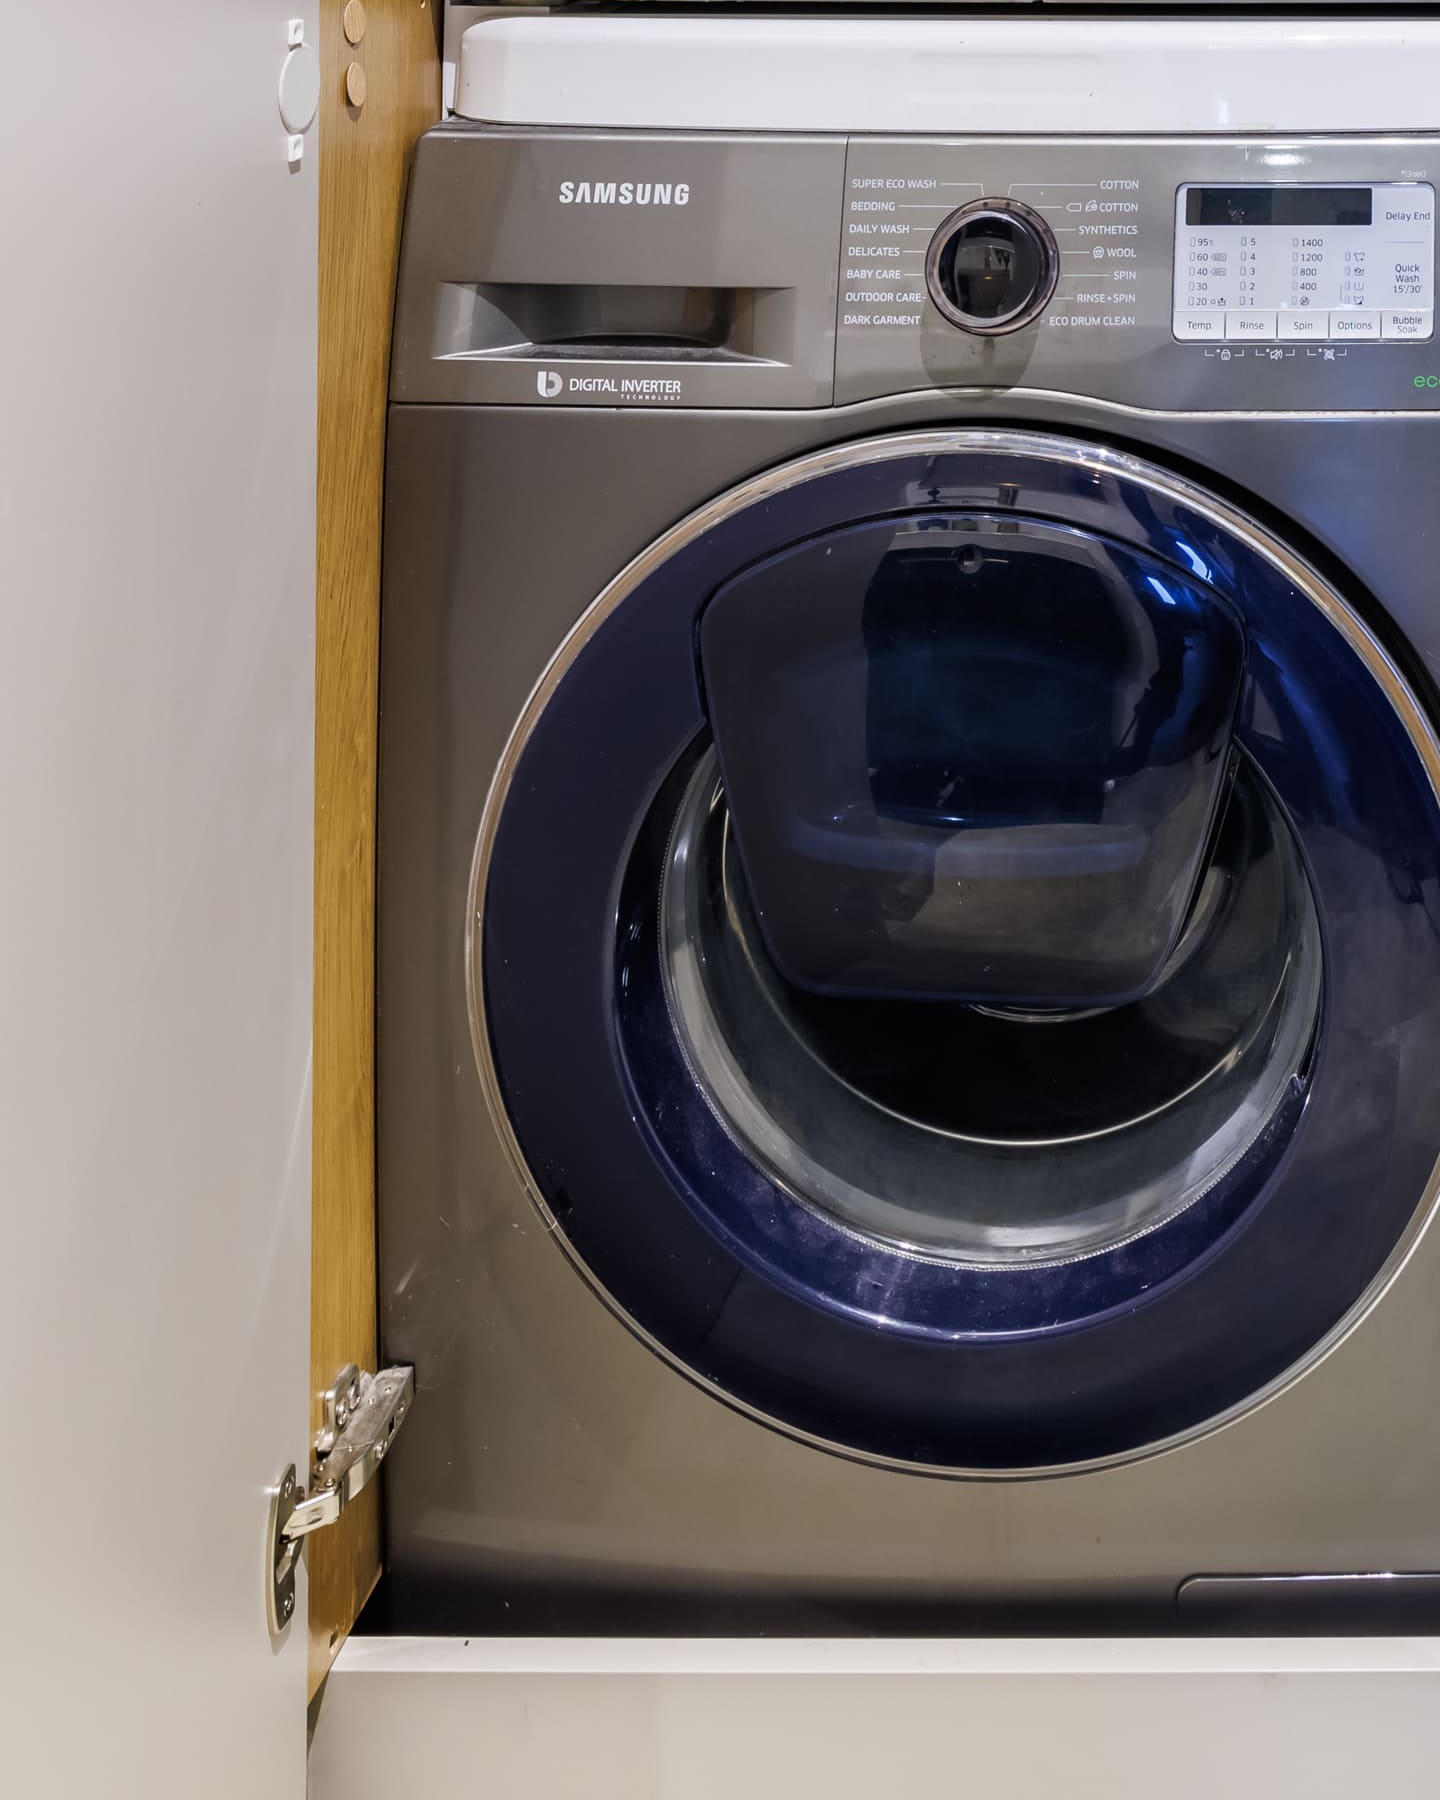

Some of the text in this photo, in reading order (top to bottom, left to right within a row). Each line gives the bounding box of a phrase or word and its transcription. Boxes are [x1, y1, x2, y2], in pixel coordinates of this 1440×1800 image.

[852, 179, 937, 189] SUPER ECO WASH
[1100, 180, 1140, 190] COTTON
[559, 181, 690, 206] SAMSUNG
[851, 202, 896, 212] BEDDING
[1100, 202, 1138, 212] COTTON
[1385, 212, 1431, 222] Delay End
[849, 224, 910, 234] DAILY WASH
[1078, 225, 1138, 236] SYNTHETICS
[1250, 237, 1257, 246] 5
[1301, 238, 1324, 247] 1400
[848, 246, 900, 257] DELICATES
[1107, 248, 1136, 258] WOOL
[1250, 252, 1256, 261] 4
[1196, 252, 1208, 262] 60
[1301, 253, 1323, 262] 1200
[1196, 267, 1208, 276] 40
[1250, 267, 1256, 276] 3
[1300, 268, 1317, 276] 800
[1394, 264, 1420, 274] Quick
[846, 270, 901, 280] BABY CARE
[1113, 270, 1136, 280] SPIN
[1396, 274, 1420, 283] Wash
[1196, 282, 1208, 291] 30
[1249, 282, 1256, 291] 2
[1299, 282, 1317, 291] 400
[846, 292, 922, 302] OUTDOOR CARE
[1195, 297, 1208, 306] 20
[1250, 297, 1255, 306] 1
[844, 314, 921, 325] DARK GARMENT
[1049, 316, 1136, 326] ECO DRUM CLEAN
[1392, 316, 1423, 326] Bubble
[1240, 321, 1264, 330] Rinse
[1294, 321, 1314, 332] Spin
[1337, 321, 1372, 332] Options
[1396, 326, 1418, 334] Soak
[570, 378, 681, 393] DIGITAL INVERTER
